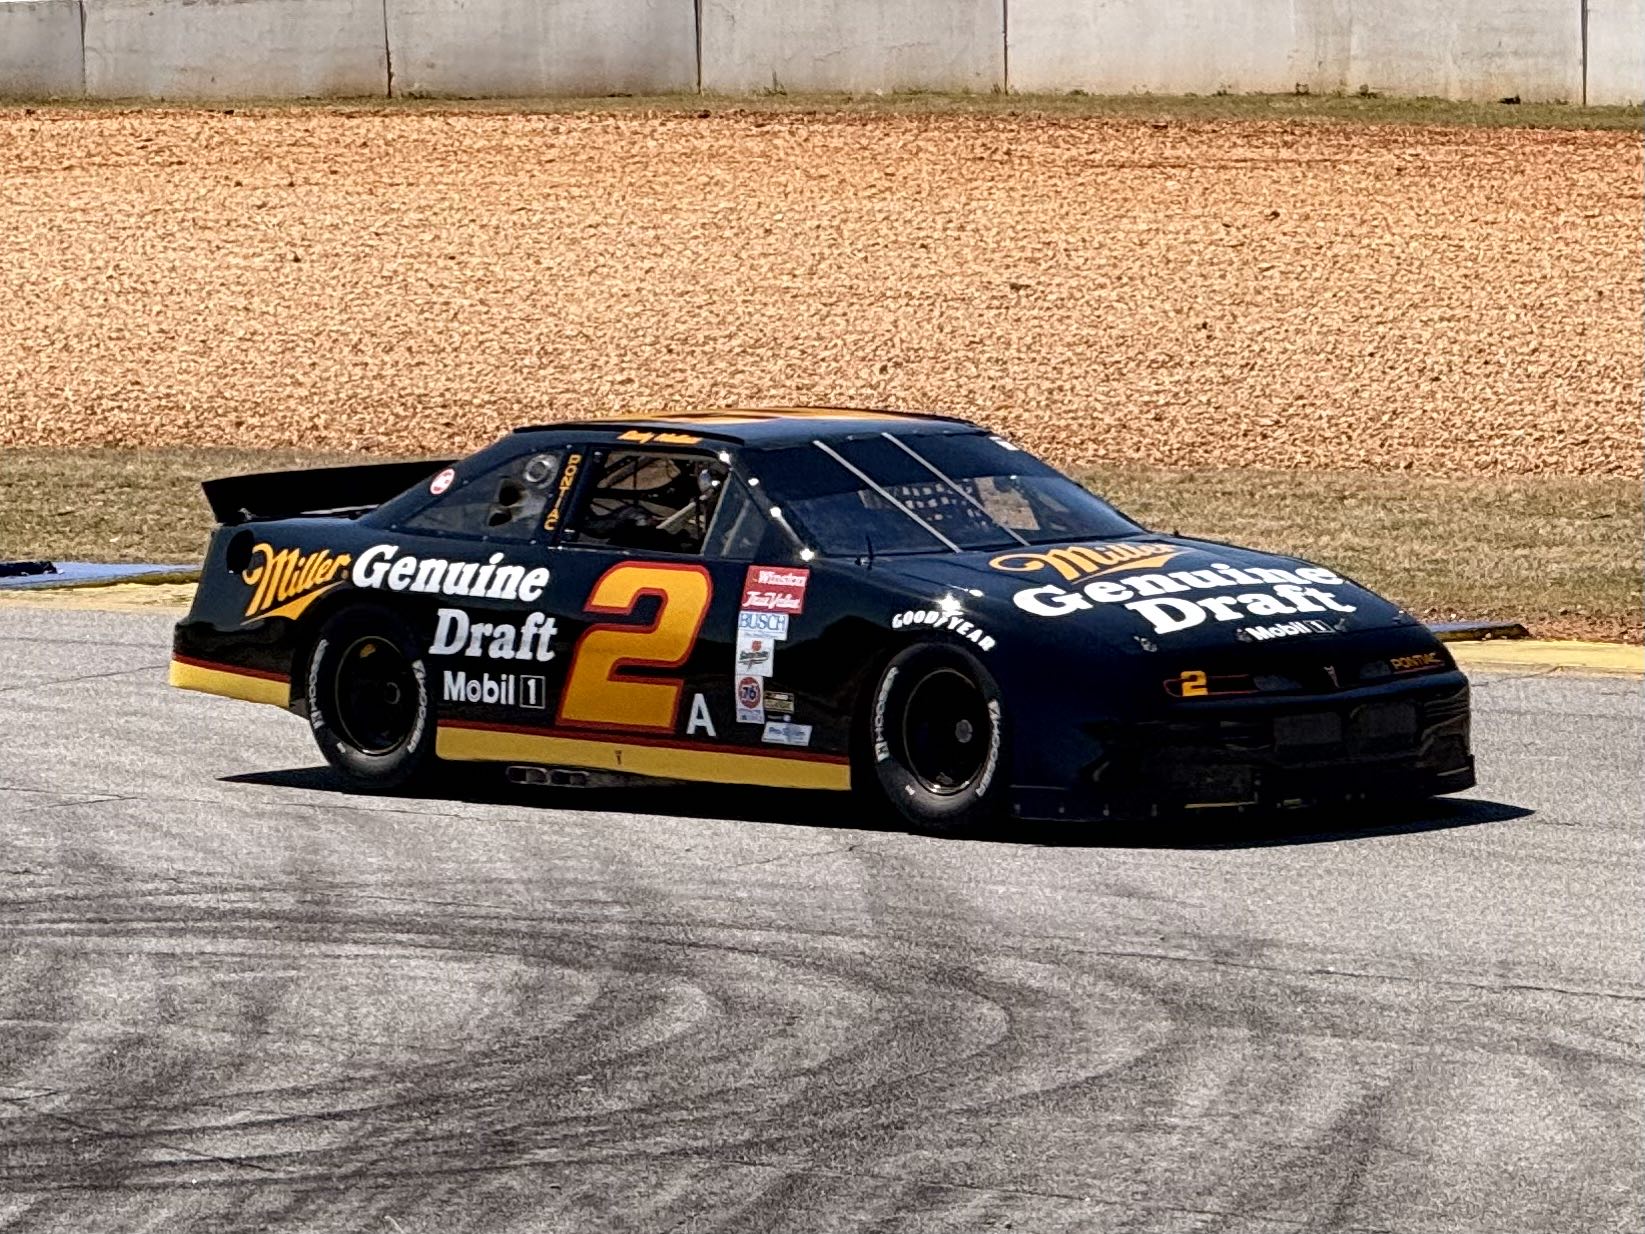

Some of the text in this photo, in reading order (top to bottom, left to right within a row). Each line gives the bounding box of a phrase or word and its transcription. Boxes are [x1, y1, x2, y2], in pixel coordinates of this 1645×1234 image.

[544, 454, 582, 530] PONTIAC
[242, 543, 352, 617] Miller
[352, 544, 550, 602] Genuine
[989, 543, 1177, 581] Miller
[1013, 563, 1345, 617] Genuine
[1124, 583, 1358, 635] Draft
[428, 608, 558, 661] Draft
[739, 613, 785, 631] BUSCH
[892, 610, 996, 651] GOODYEAR
[1245, 621, 1313, 640] Mobil
[555, 560, 715, 734] 2
[1390, 652, 1440, 669] PONTIAC
[443, 671, 515, 706] Mobil
[1180, 670, 1207, 697] 2
[686, 693, 717, 737] A
